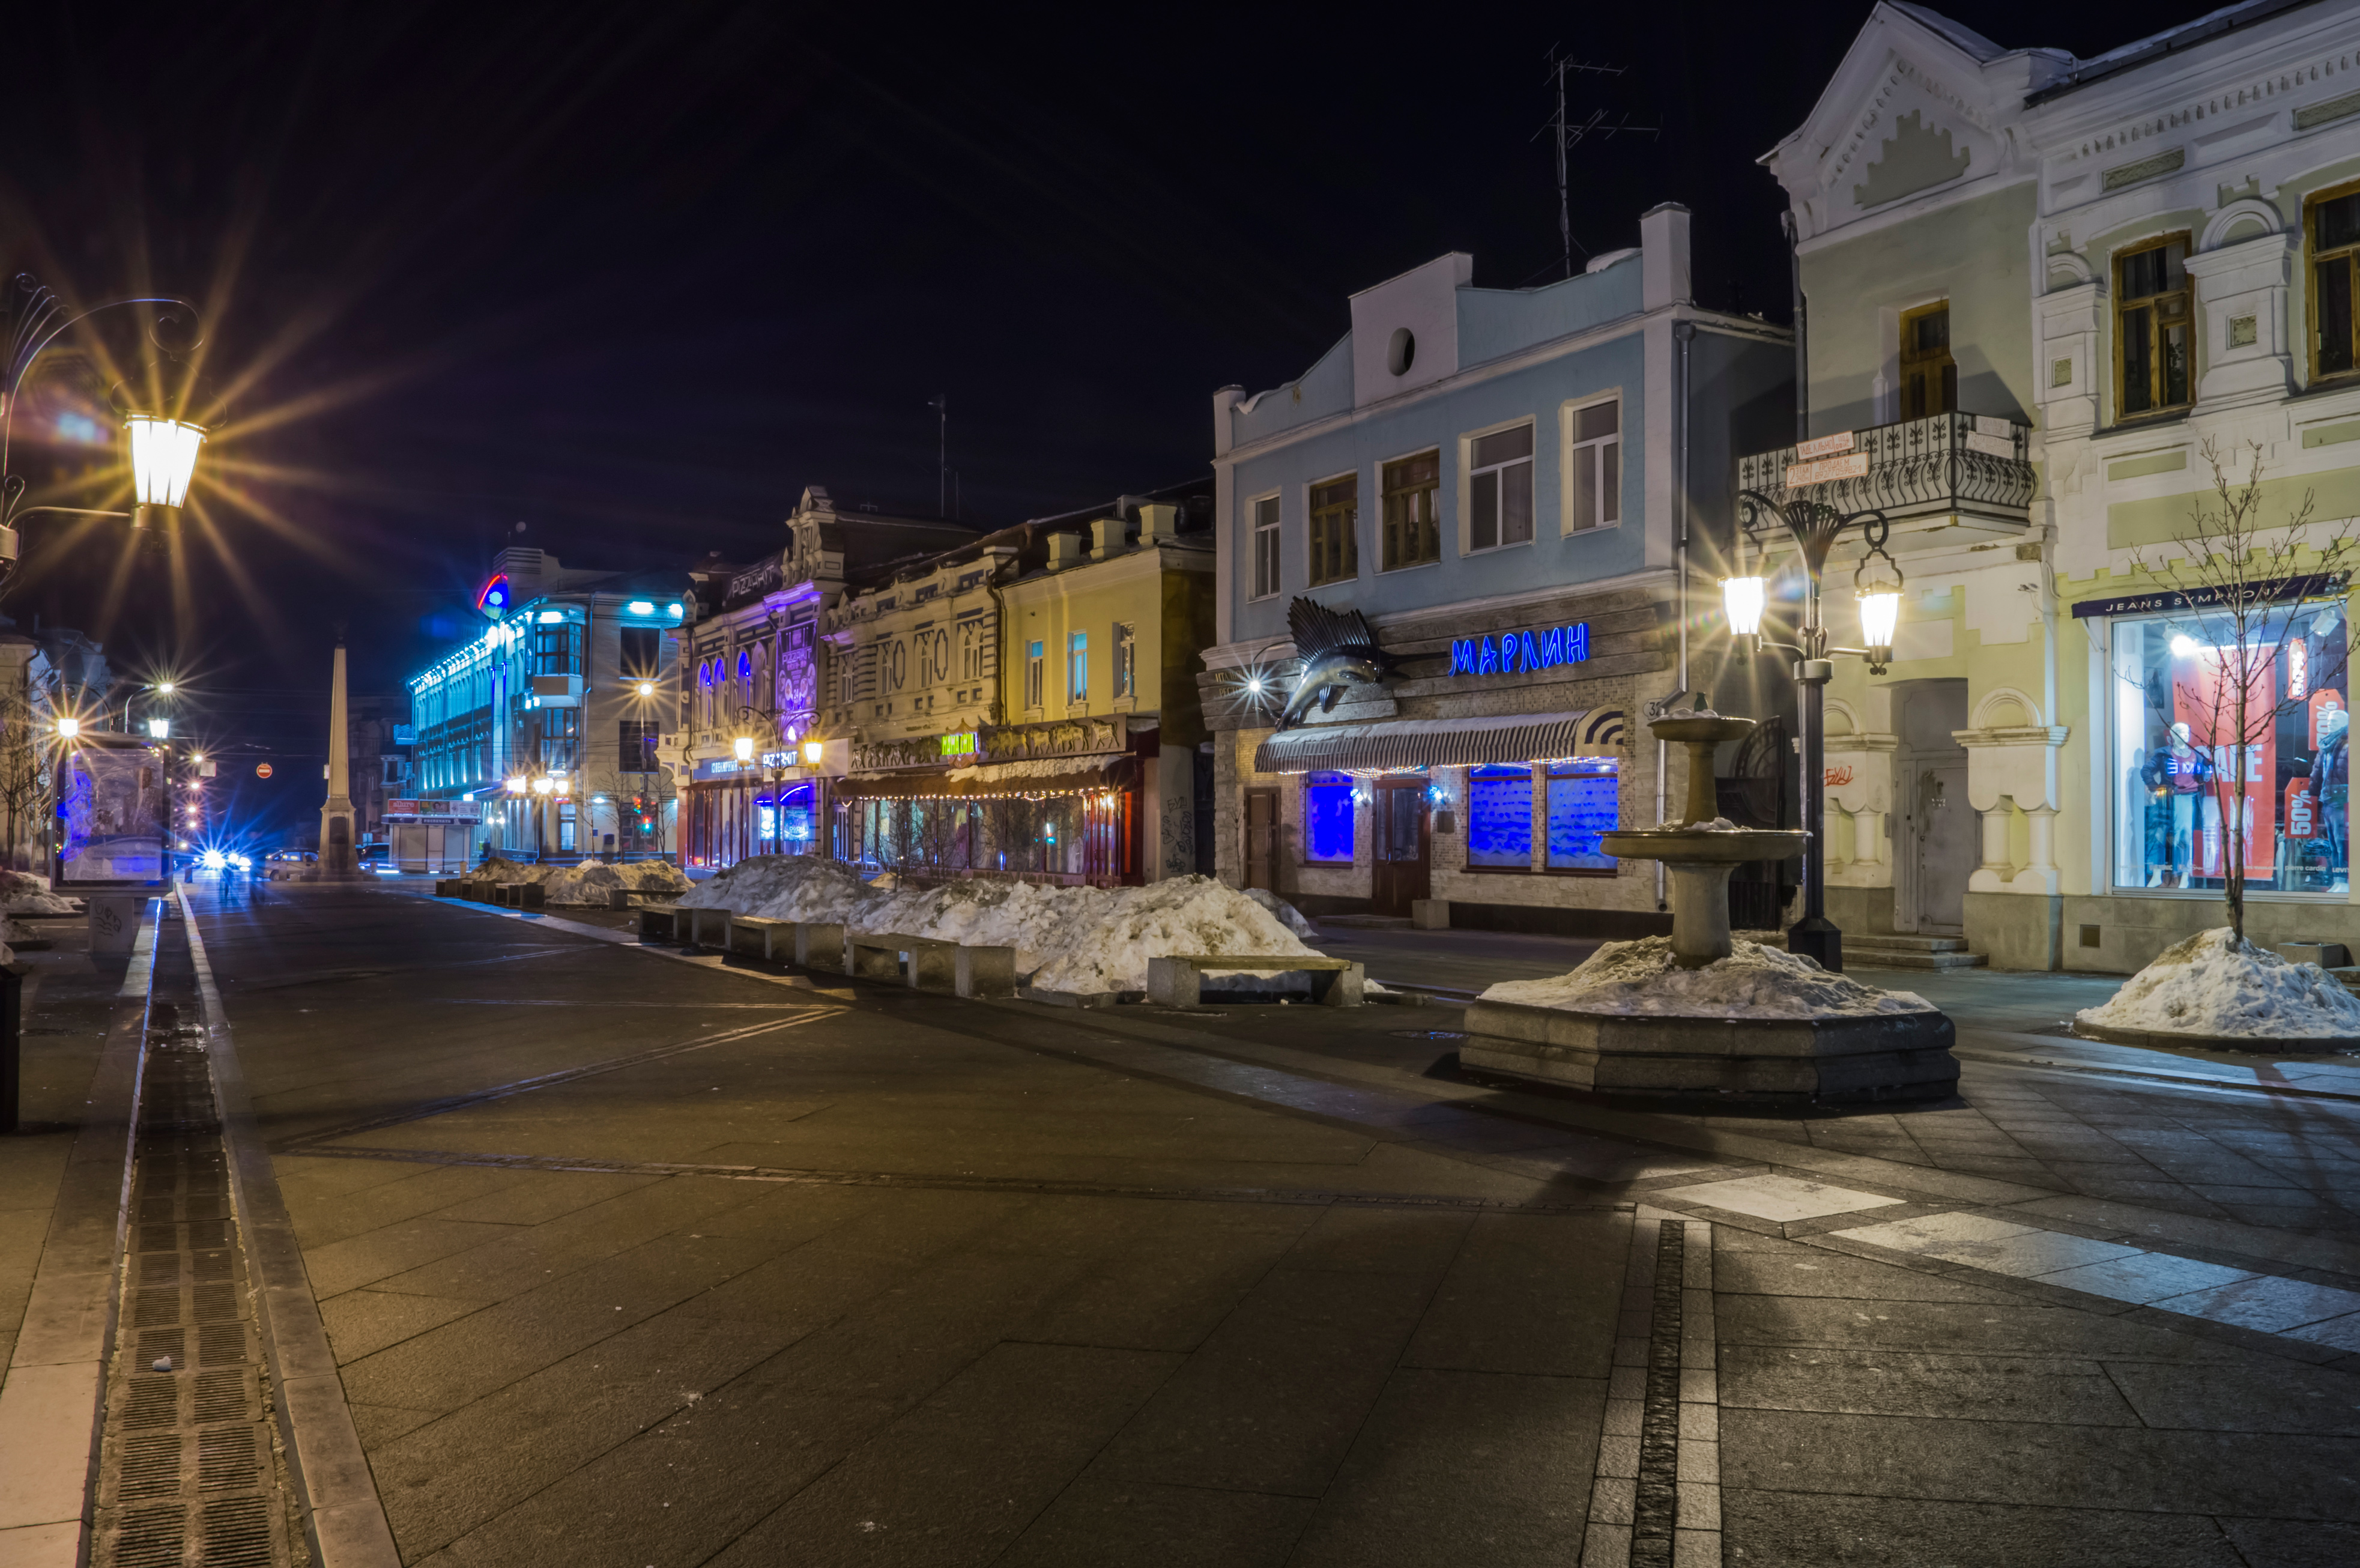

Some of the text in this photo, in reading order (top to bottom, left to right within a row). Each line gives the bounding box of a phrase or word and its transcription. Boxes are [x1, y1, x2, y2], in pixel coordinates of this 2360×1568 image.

[1800, 439, 1833, 456] ИДЕАЛЬНО
[1819, 458, 1850, 471] ПРОДАЕМ
[1789, 468, 1796, 485] 2
[2105, 599, 2162, 611] JEANS
[1448, 622, 1589, 677] МАРЛИН
[2291, 790, 2312, 835] 50%
